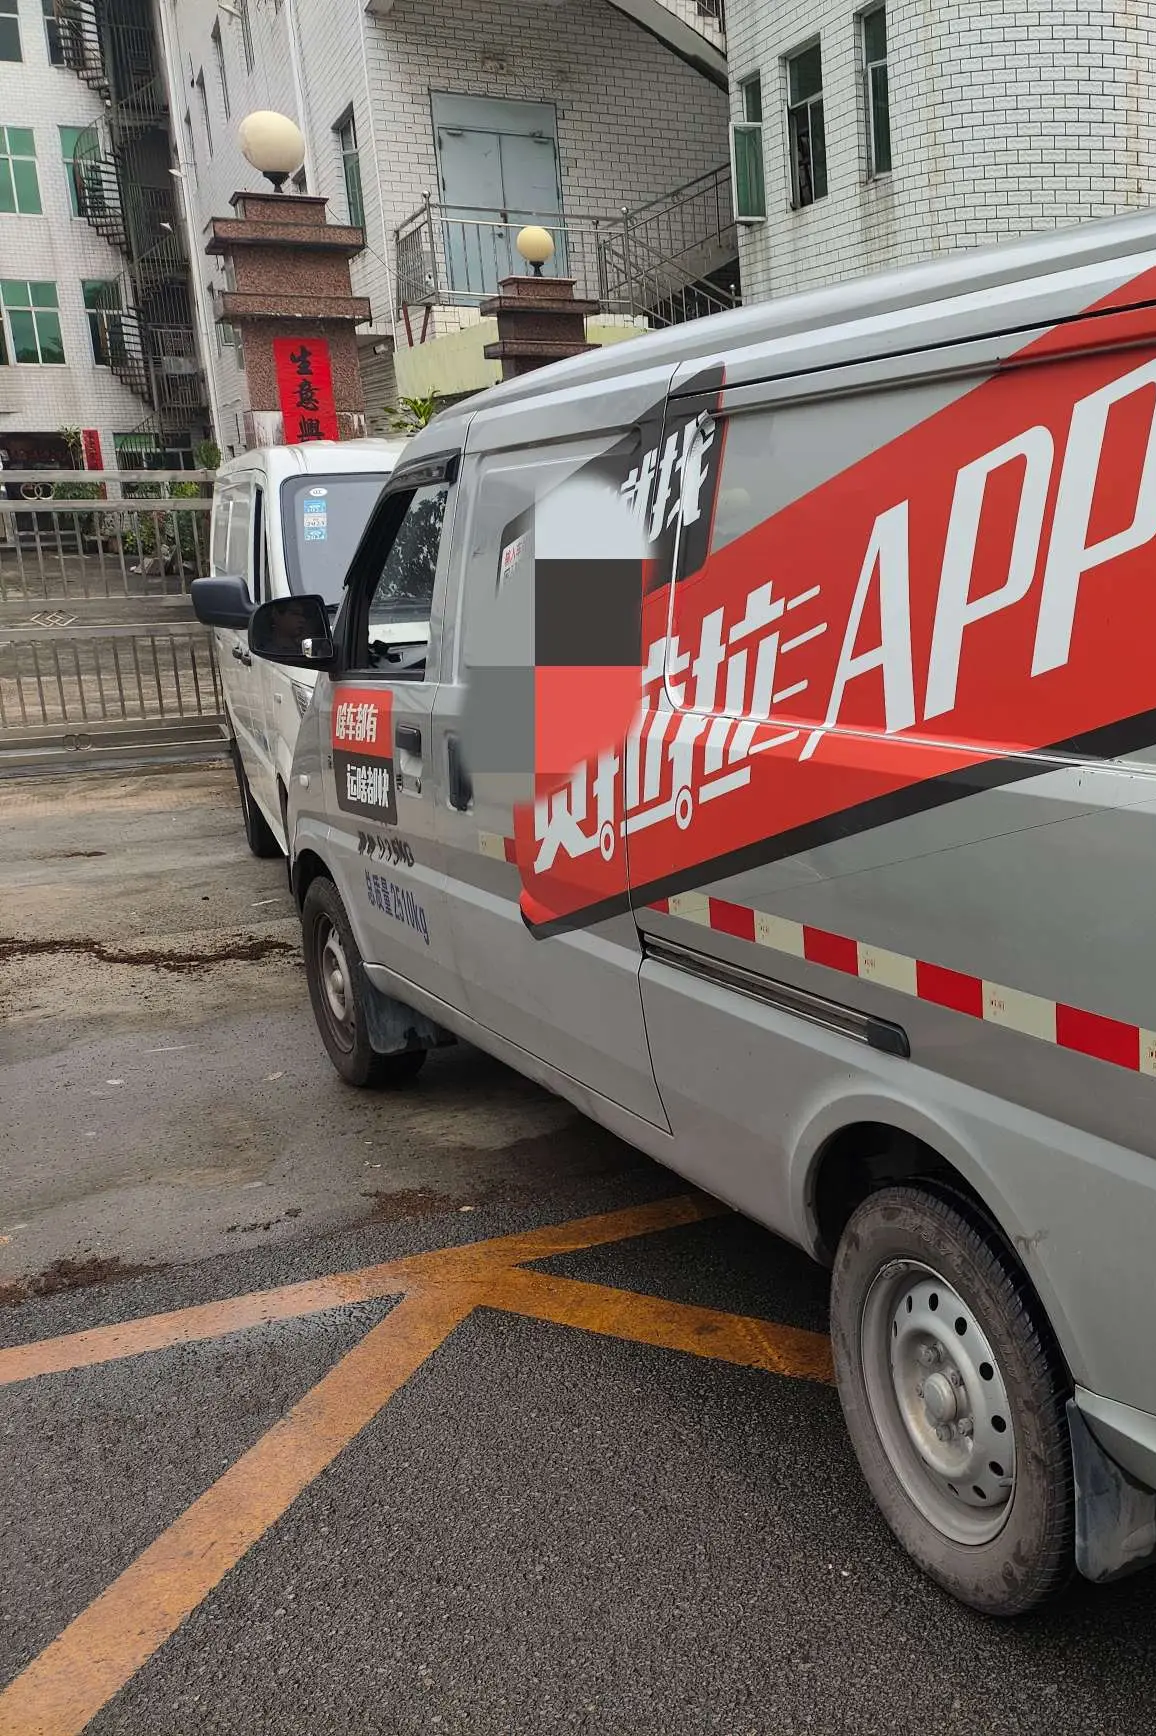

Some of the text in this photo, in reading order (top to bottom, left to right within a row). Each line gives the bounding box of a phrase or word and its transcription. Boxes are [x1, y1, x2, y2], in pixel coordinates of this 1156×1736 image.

[335, 702, 378, 743] 啥车都有
[346, 763, 389, 809] 运啥都快
